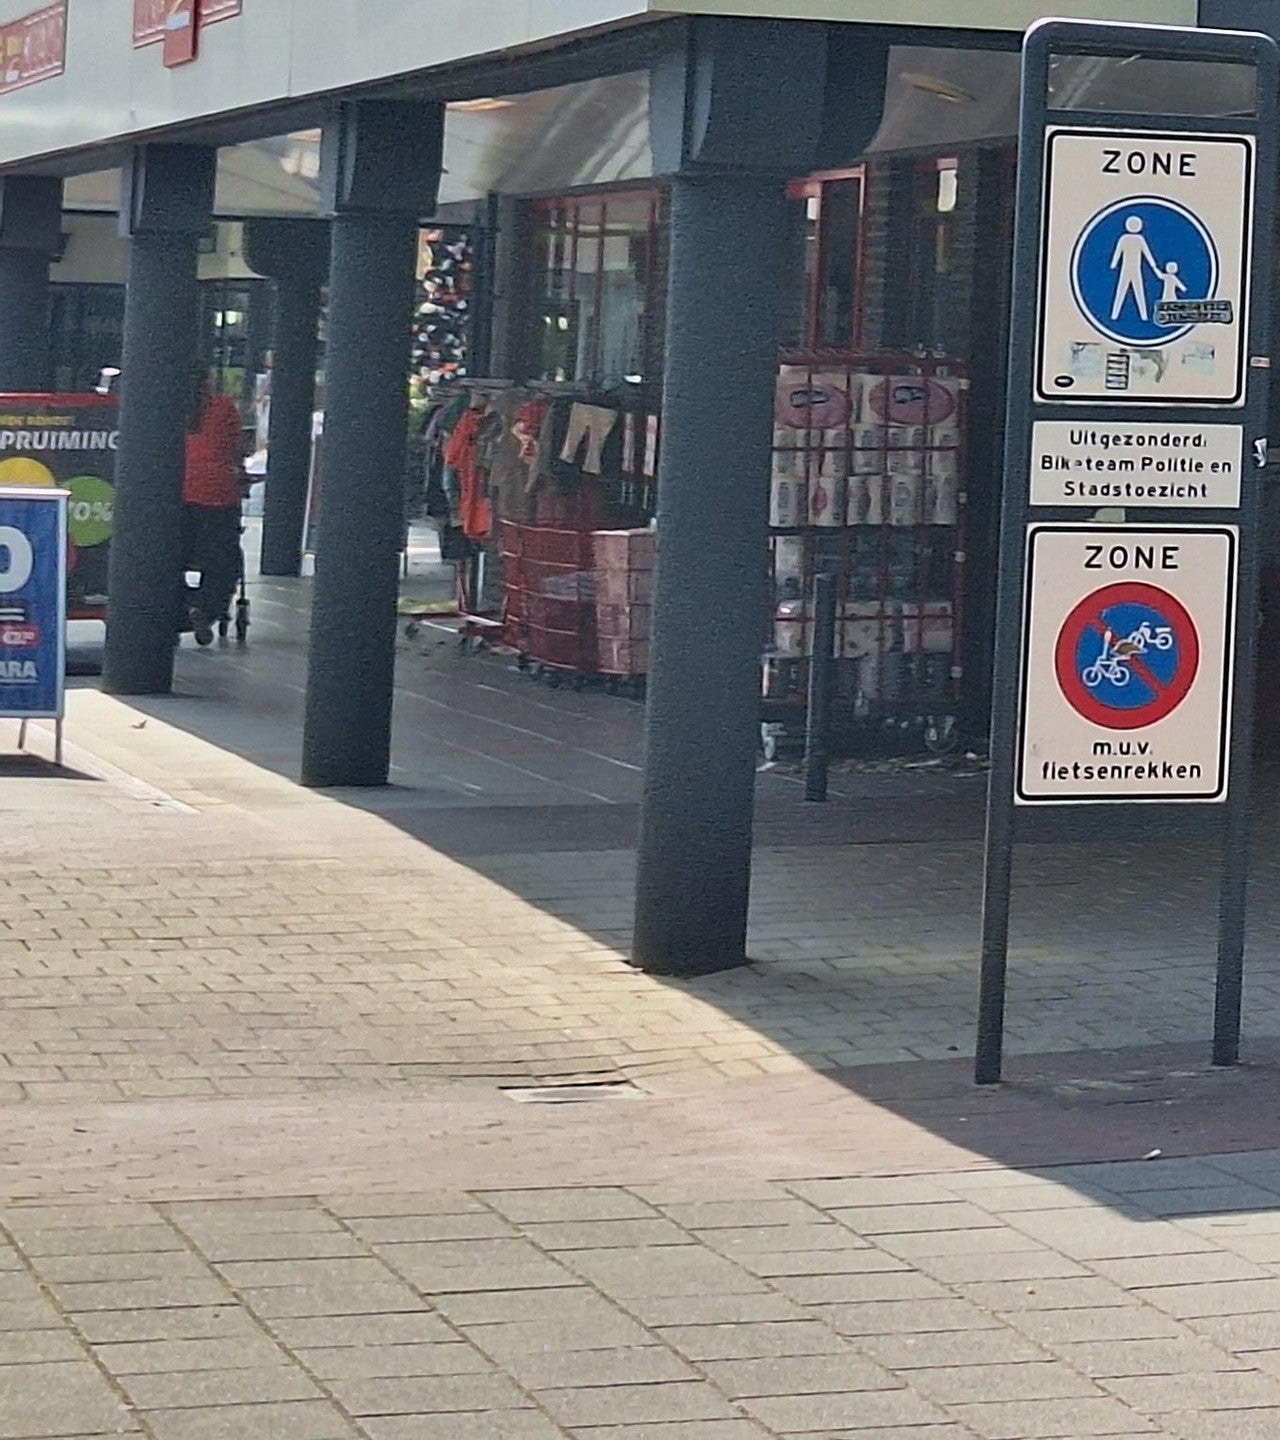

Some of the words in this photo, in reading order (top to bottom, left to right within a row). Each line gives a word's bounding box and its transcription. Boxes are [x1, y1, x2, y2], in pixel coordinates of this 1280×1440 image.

[1102, 150, 1197, 176] ZONE
[1141, 457, 1203, 472] Politie
[1210, 461, 1231, 473] en
[1064, 481, 1207, 498] Stadstoezicht
[69, 501, 113, 522] 0%
[1085, 546, 1179, 569] ZONE
[1042, 761, 1201, 780] fietsenrekken
